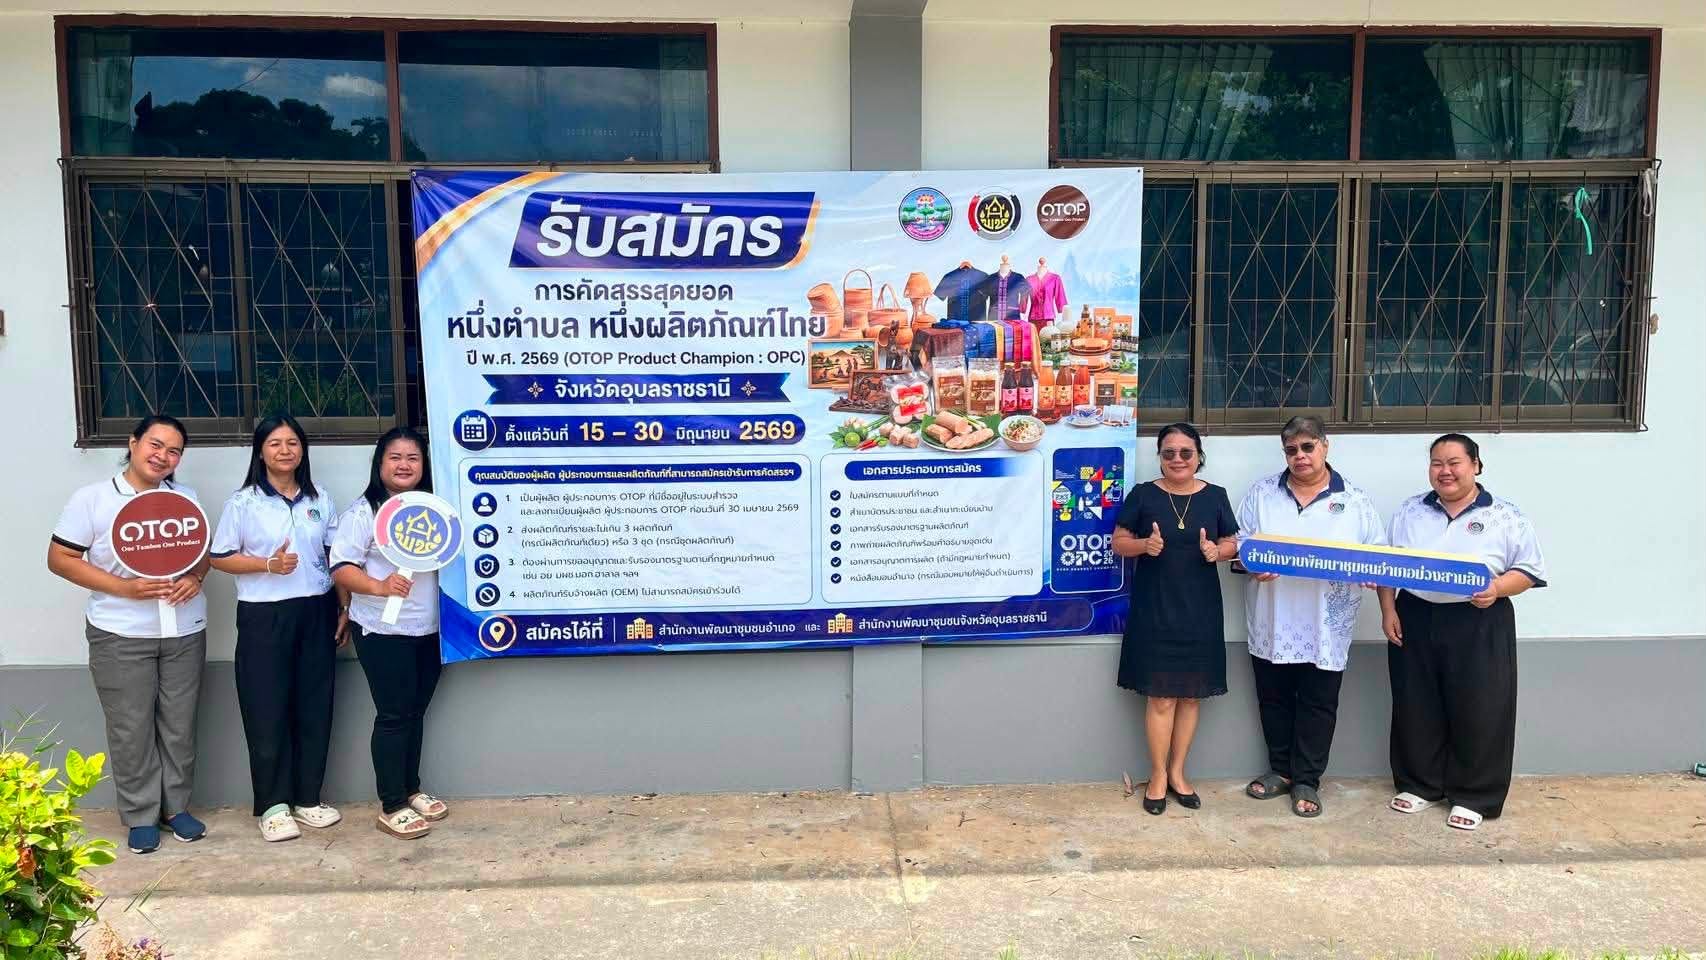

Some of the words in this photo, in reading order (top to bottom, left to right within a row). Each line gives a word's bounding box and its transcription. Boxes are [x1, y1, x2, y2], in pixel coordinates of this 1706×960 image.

[1041, 203, 1087, 216] OTOP
[537, 198, 783, 257] รับสมัคร
[535, 279, 734, 308] การคัดสรรสุดยอด
[447, 299, 580, 339] หนึ่งตำบล
[589, 300, 827, 339] หนึ่งผลิตภัณฑ์ไทย
[466, 349, 478, 366] ปี
[482, 351, 516, 366] พ.ศ.
[521, 351, 559, 366] 2569
[564, 351, 613, 368] (OTOP
[618, 351, 677, 365] Product
[680, 350, 754, 367] Champion
[767, 350, 806, 366] OPC)
[505, 423, 569, 441] ตั้งแต่วันที่
[579, 422, 605, 441] 15
[633, 421, 664, 441] 30
[676, 427, 730, 445] มิถุนายน
[739, 420, 796, 441] 2569
[863, 463, 982, 476] เอกสารประกอบการสมัคร
[619, 492, 646, 502] OTOP
[660, 506, 687, 514] OTOP
[728, 505, 740, 513] 30
[743, 505, 774, 513] เมษายน
[776, 504, 800, 512] 2569
[120, 516, 200, 542] OTOP
[624, 524, 630, 533] 3
[162, 541, 176, 549] One
[176, 539, 201, 547] Product
[632, 538, 638, 546] 3
[1060, 533, 1113, 551] OTOP
[1060, 550, 1103, 567] OPC
[1247, 548, 1486, 587] สำนักงานพัฒนาชุมชนอำเภอม่วงสามสิบ
[611, 588, 639, 597] (OEM)
[525, 616, 604, 641] สมัครได้ที่
[658, 621, 796, 637] สำนักงานพัฒนาชุมชนอำเภอ
[804, 623, 821, 632] และ
[858, 611, 1048, 631] สำนักงานพัฒนาชุมชนจังหวัดอุบลราชธานี
